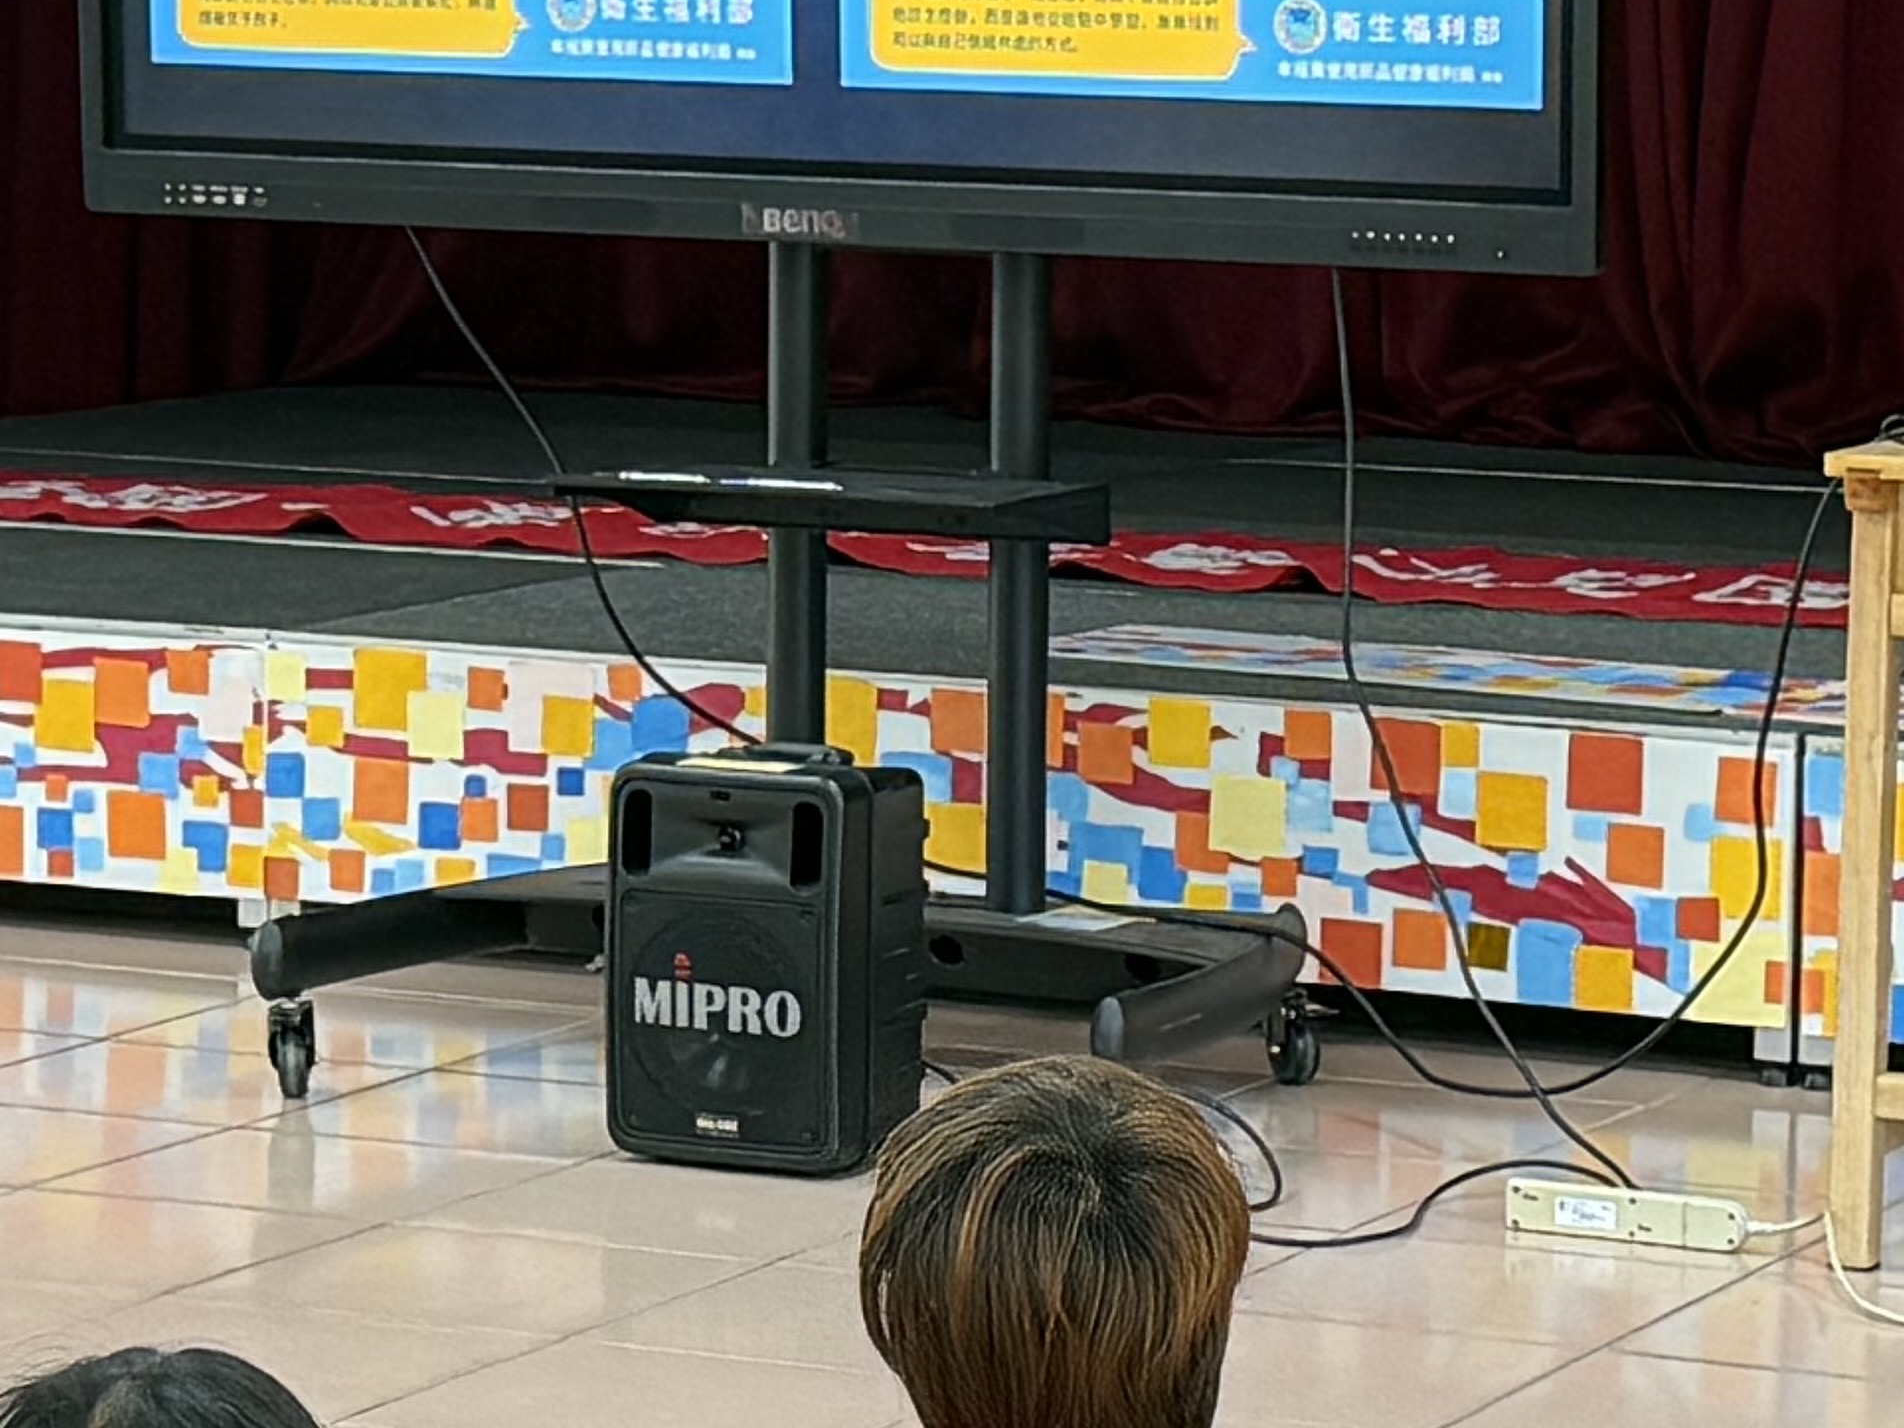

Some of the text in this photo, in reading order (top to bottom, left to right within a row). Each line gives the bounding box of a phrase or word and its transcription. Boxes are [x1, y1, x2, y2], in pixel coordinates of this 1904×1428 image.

[1332, 11, 1500, 46] 衛生福利部
